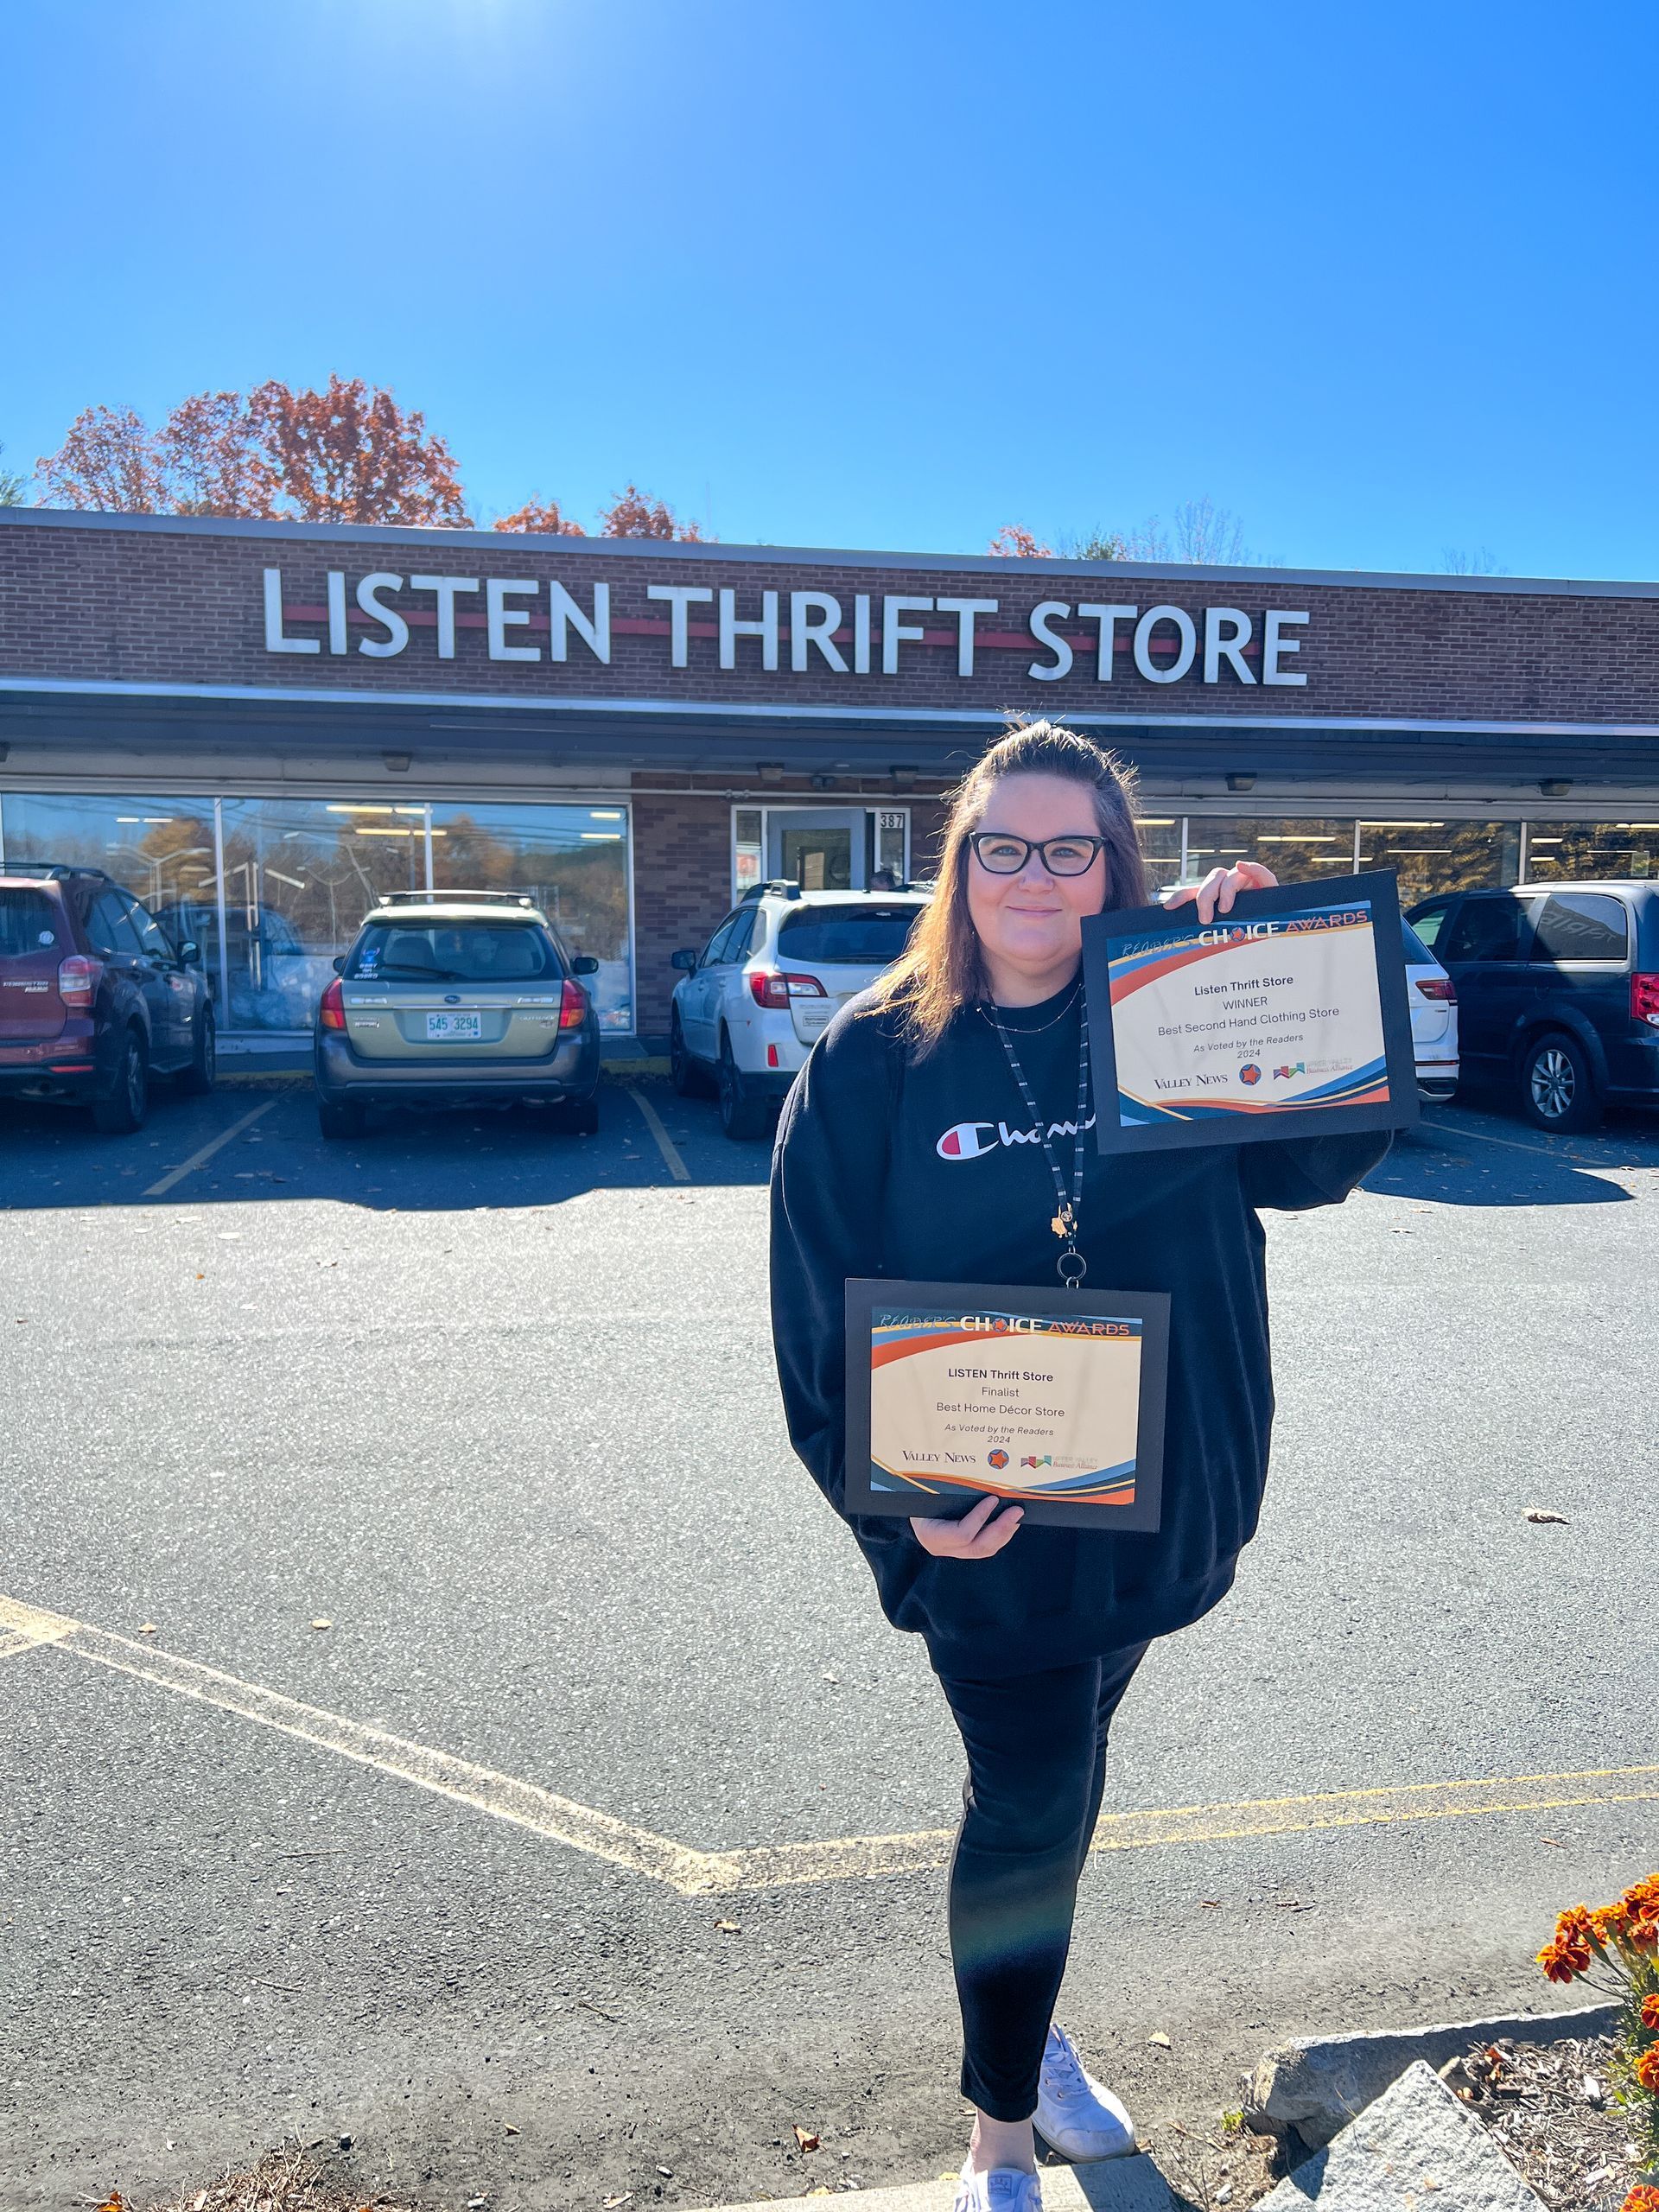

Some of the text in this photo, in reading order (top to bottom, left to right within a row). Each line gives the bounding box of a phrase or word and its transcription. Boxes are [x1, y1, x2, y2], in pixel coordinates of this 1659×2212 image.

[264, 569, 1311, 686] LISTEN THRIFT STORE
[880, 815, 902, 828] 387
[1286, 911, 1367, 932] AWARDS
[1194, 976, 1294, 996] Listen Thrift Store
[1223, 996, 1268, 1010] WINNER
[429, 1017, 478, 1030] 545 3294
[1158, 1007, 1339, 1036] Best Second Hand Clothing Store
[1208, 1040, 1234, 1051] Voted
[1236, 1039, 1247, 1049] by
[1249, 1038, 1264, 1046] the
[1266, 1033, 1304, 1045] Readers
[1236, 1049, 1261, 1059] 2024
[1154, 1074, 1228, 1090] VALLEY NEWS
[937, 1113, 1096, 1160] Cham
[1048, 1321, 1129, 1335] AWARDS
[949, 1369, 1053, 1382] LISTEN Thrift Store
[982, 1387, 1019, 1397] Finalist
[937, 1402, 1065, 1417] Best Home Décor Store
[959, 1424, 985, 1433] Voted
[988, 1425, 998, 1434] by
[1001, 1426, 1014, 1434] the
[1018, 1427, 1053, 1435] Readers
[903, 1451, 976, 1463] VALLEY NEWS
